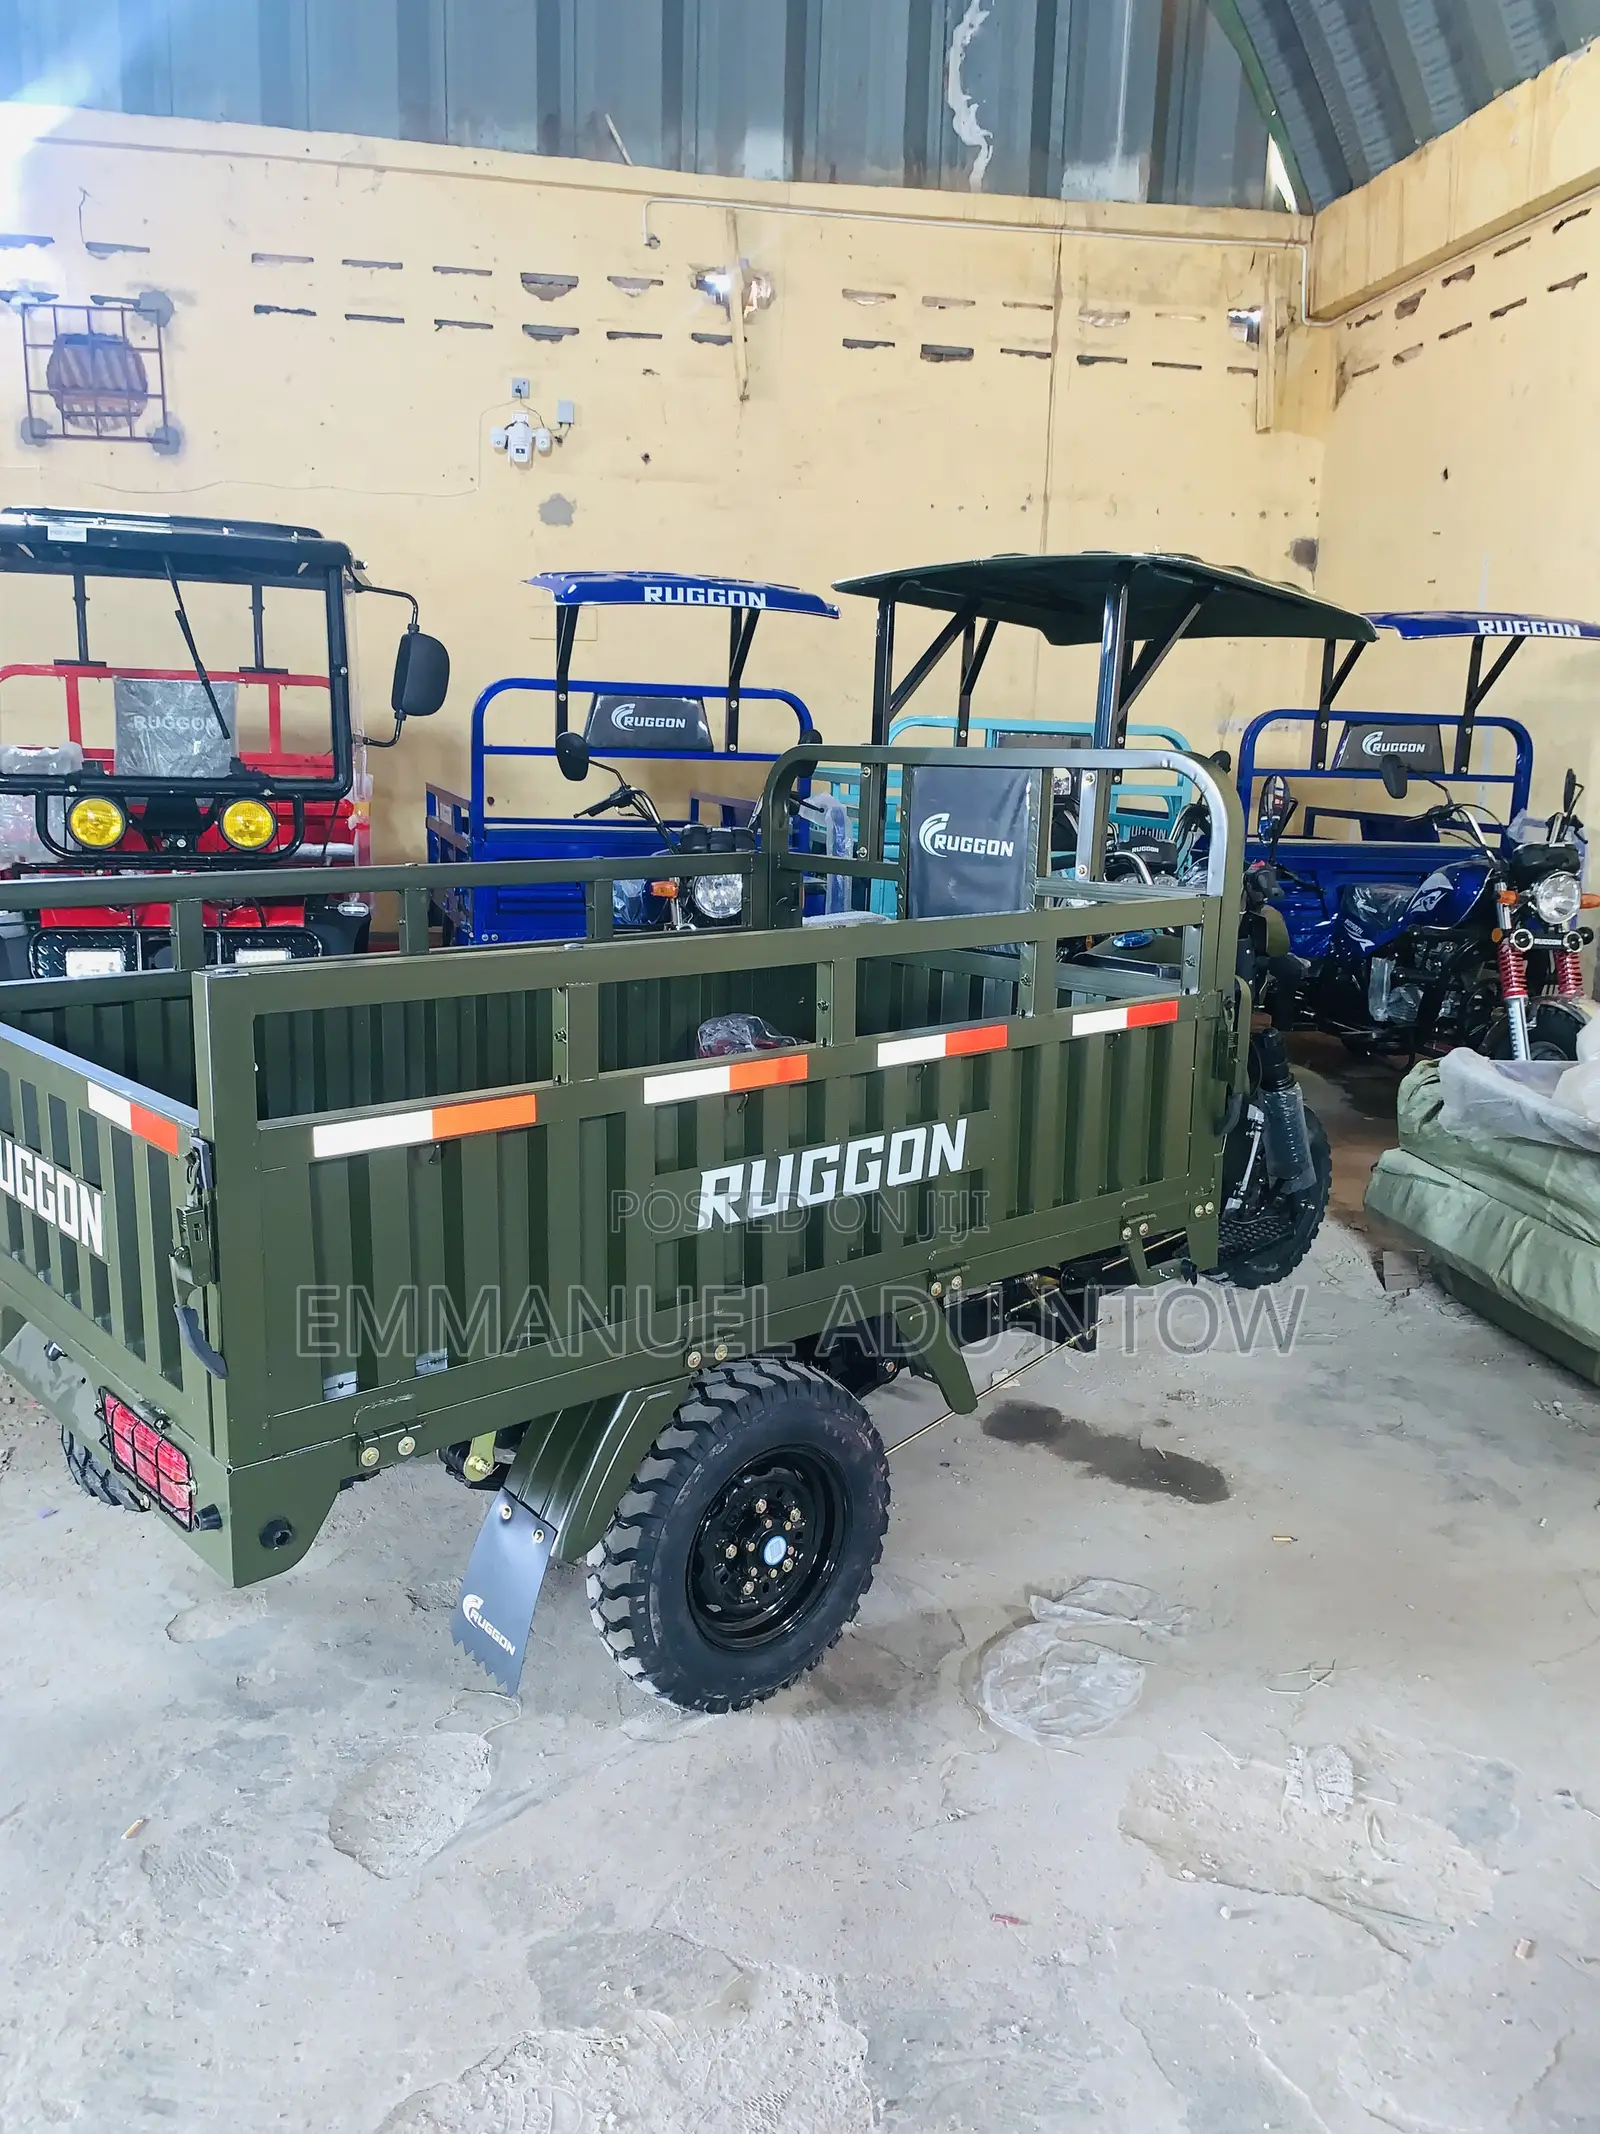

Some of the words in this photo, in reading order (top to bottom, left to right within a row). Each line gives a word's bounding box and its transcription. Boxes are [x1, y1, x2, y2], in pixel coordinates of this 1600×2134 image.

[643, 586, 767, 608] RUGGON
[1477, 620, 1582, 637] RUGGON
[133, 714, 220, 734] RUGGON
[624, 716, 686, 729] RUGGON
[1372, 742, 1426, 753] RUGGON
[934, 833, 1015, 857] RUGGON
[697, 1118, 968, 1231] RUGGON
[0, 1133, 104, 1257] UGGON
[470, 1607, 516, 1656] RUGGON
